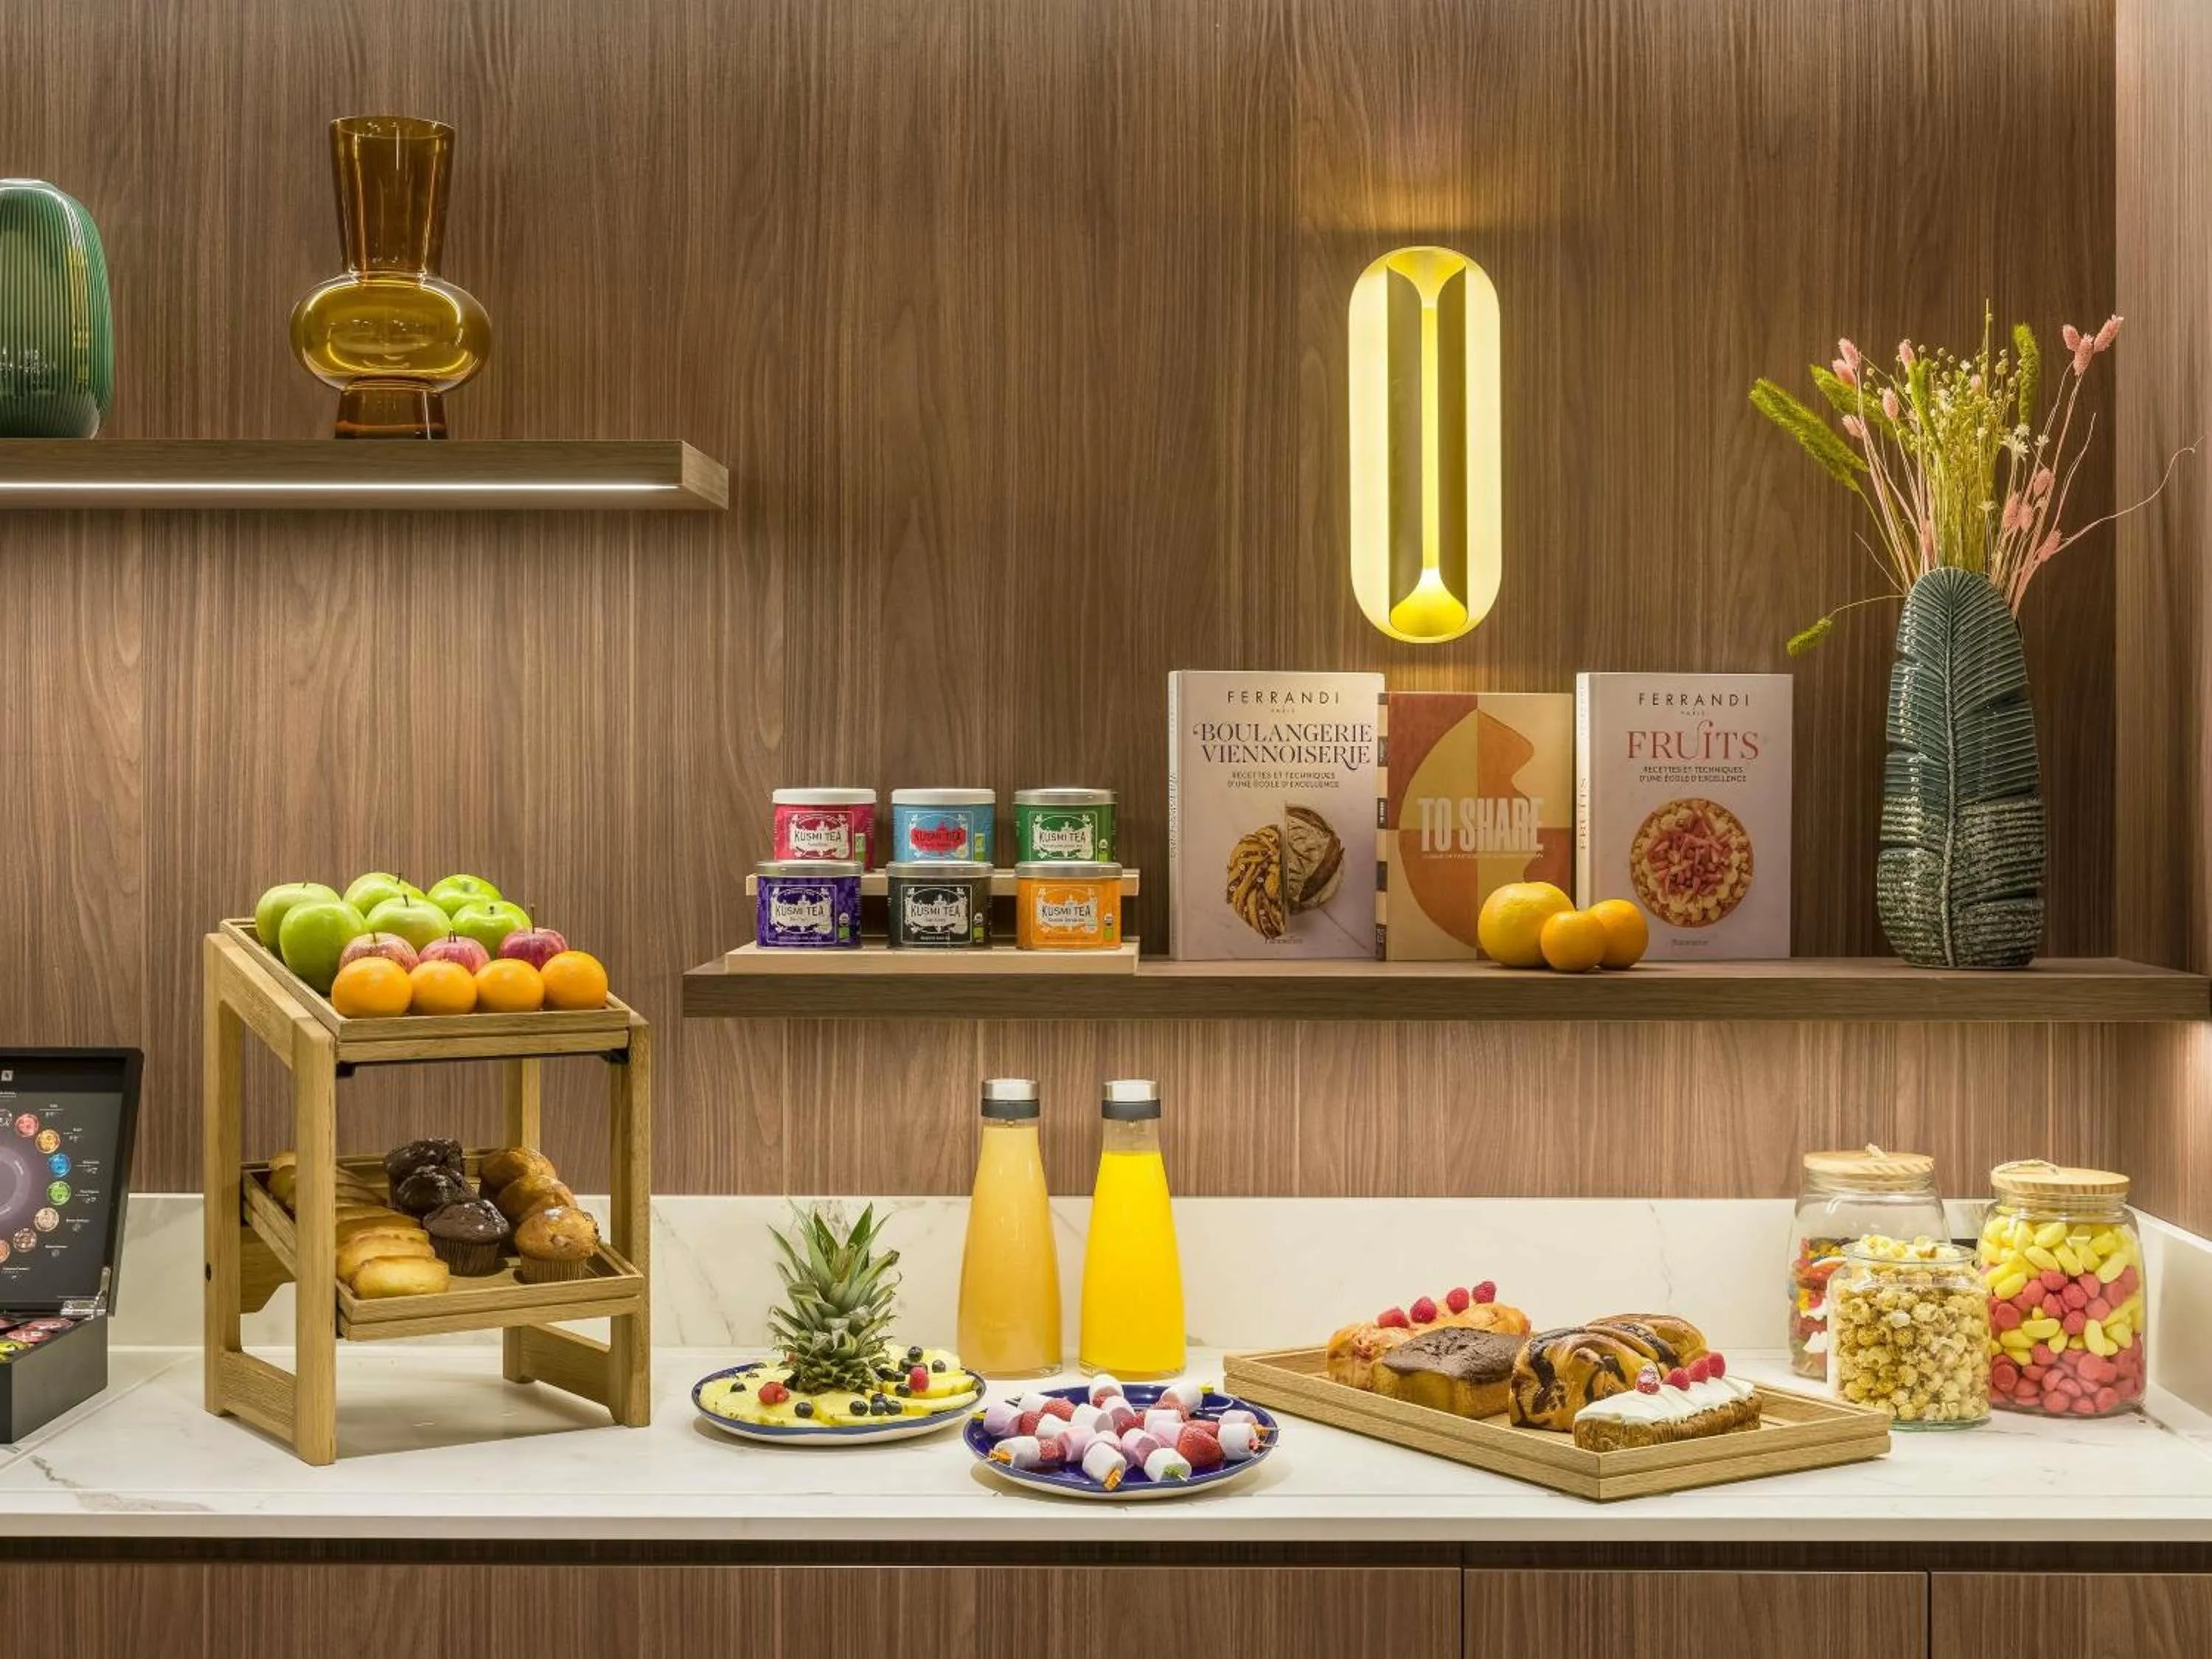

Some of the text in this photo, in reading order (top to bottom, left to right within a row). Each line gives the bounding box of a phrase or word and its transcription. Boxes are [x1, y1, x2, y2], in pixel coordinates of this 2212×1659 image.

[1227, 691, 1339, 704] FERRANDI
[1638, 692, 1749, 706] FERRANDI
[1192, 723, 1372, 742] BOULANGERIE
[1626, 719, 1759, 760] FRUITS
[1202, 745, 1371, 771] VIENNOISERIE
[1417, 797, 1452, 852] TO
[1459, 797, 1545, 852] SHARE
[794, 830, 842, 842] KUSMI TEA
[1039, 831, 1086, 844] KUSMI TEA
[775, 905, 824, 917] KUSMI TEA
[911, 905, 961, 917] KUSMI TEA
[1042, 905, 1091, 917] KUSMI TEA
